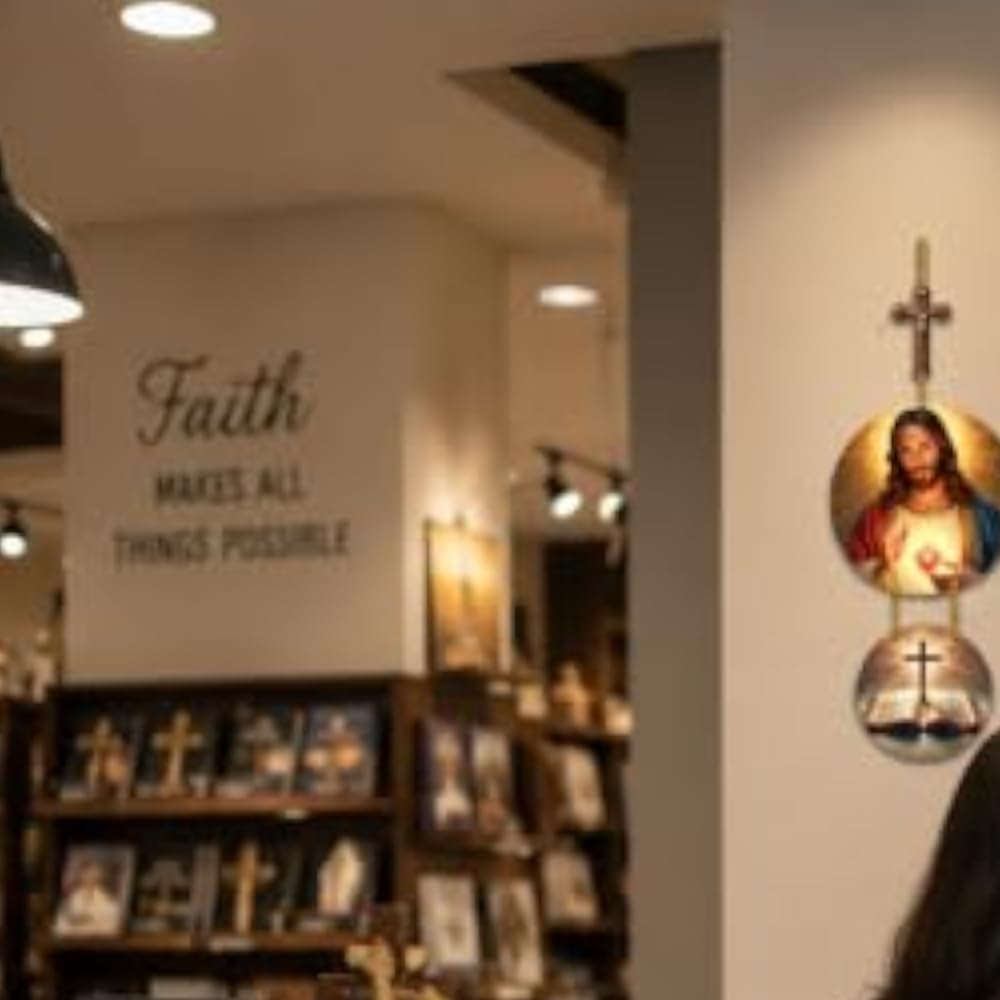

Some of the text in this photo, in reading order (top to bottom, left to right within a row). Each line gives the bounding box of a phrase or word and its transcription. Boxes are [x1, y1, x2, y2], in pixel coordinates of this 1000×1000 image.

[136, 349, 311, 446] Faith
[154, 464, 307, 506] MAKES ALL
[113, 520, 351, 570] THINGS POSSIBLE
